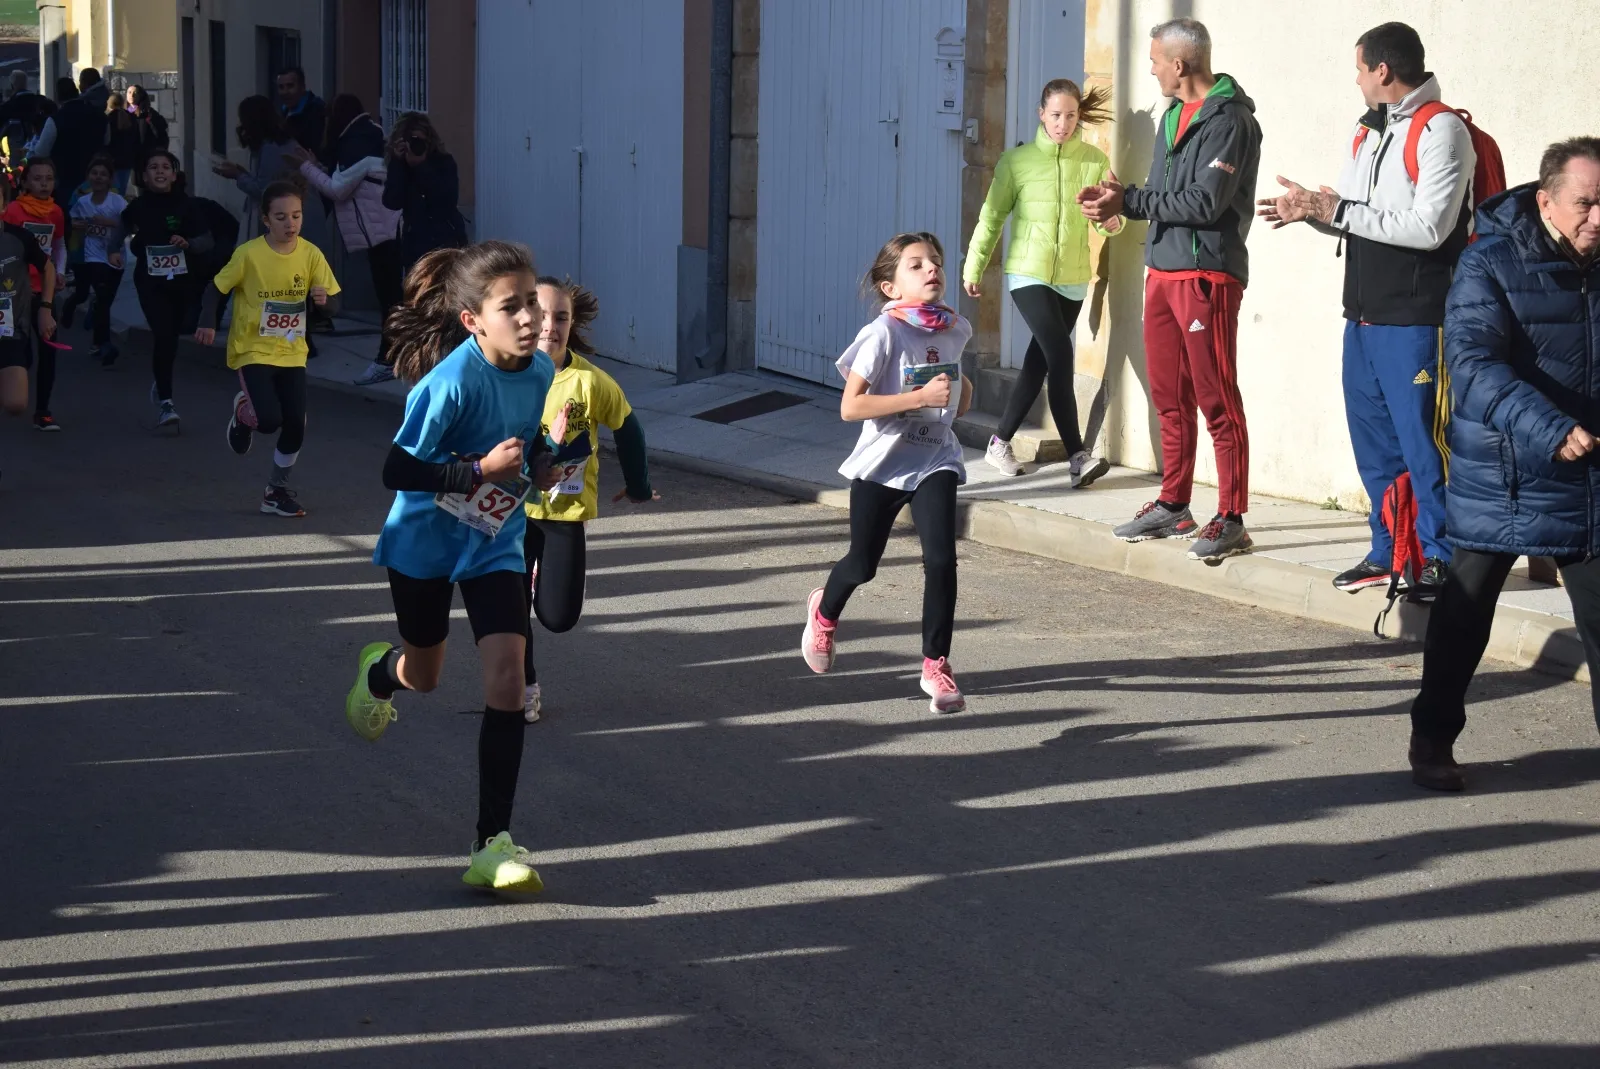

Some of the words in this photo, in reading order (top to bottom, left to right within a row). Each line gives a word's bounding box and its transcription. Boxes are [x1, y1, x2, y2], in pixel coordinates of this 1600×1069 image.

[87, 224, 107, 236] 200
[152, 255, 180, 269] 320
[271, 289, 284, 298] LOS
[284, 289, 306, 297] LEONES
[266, 313, 300, 329] 886
